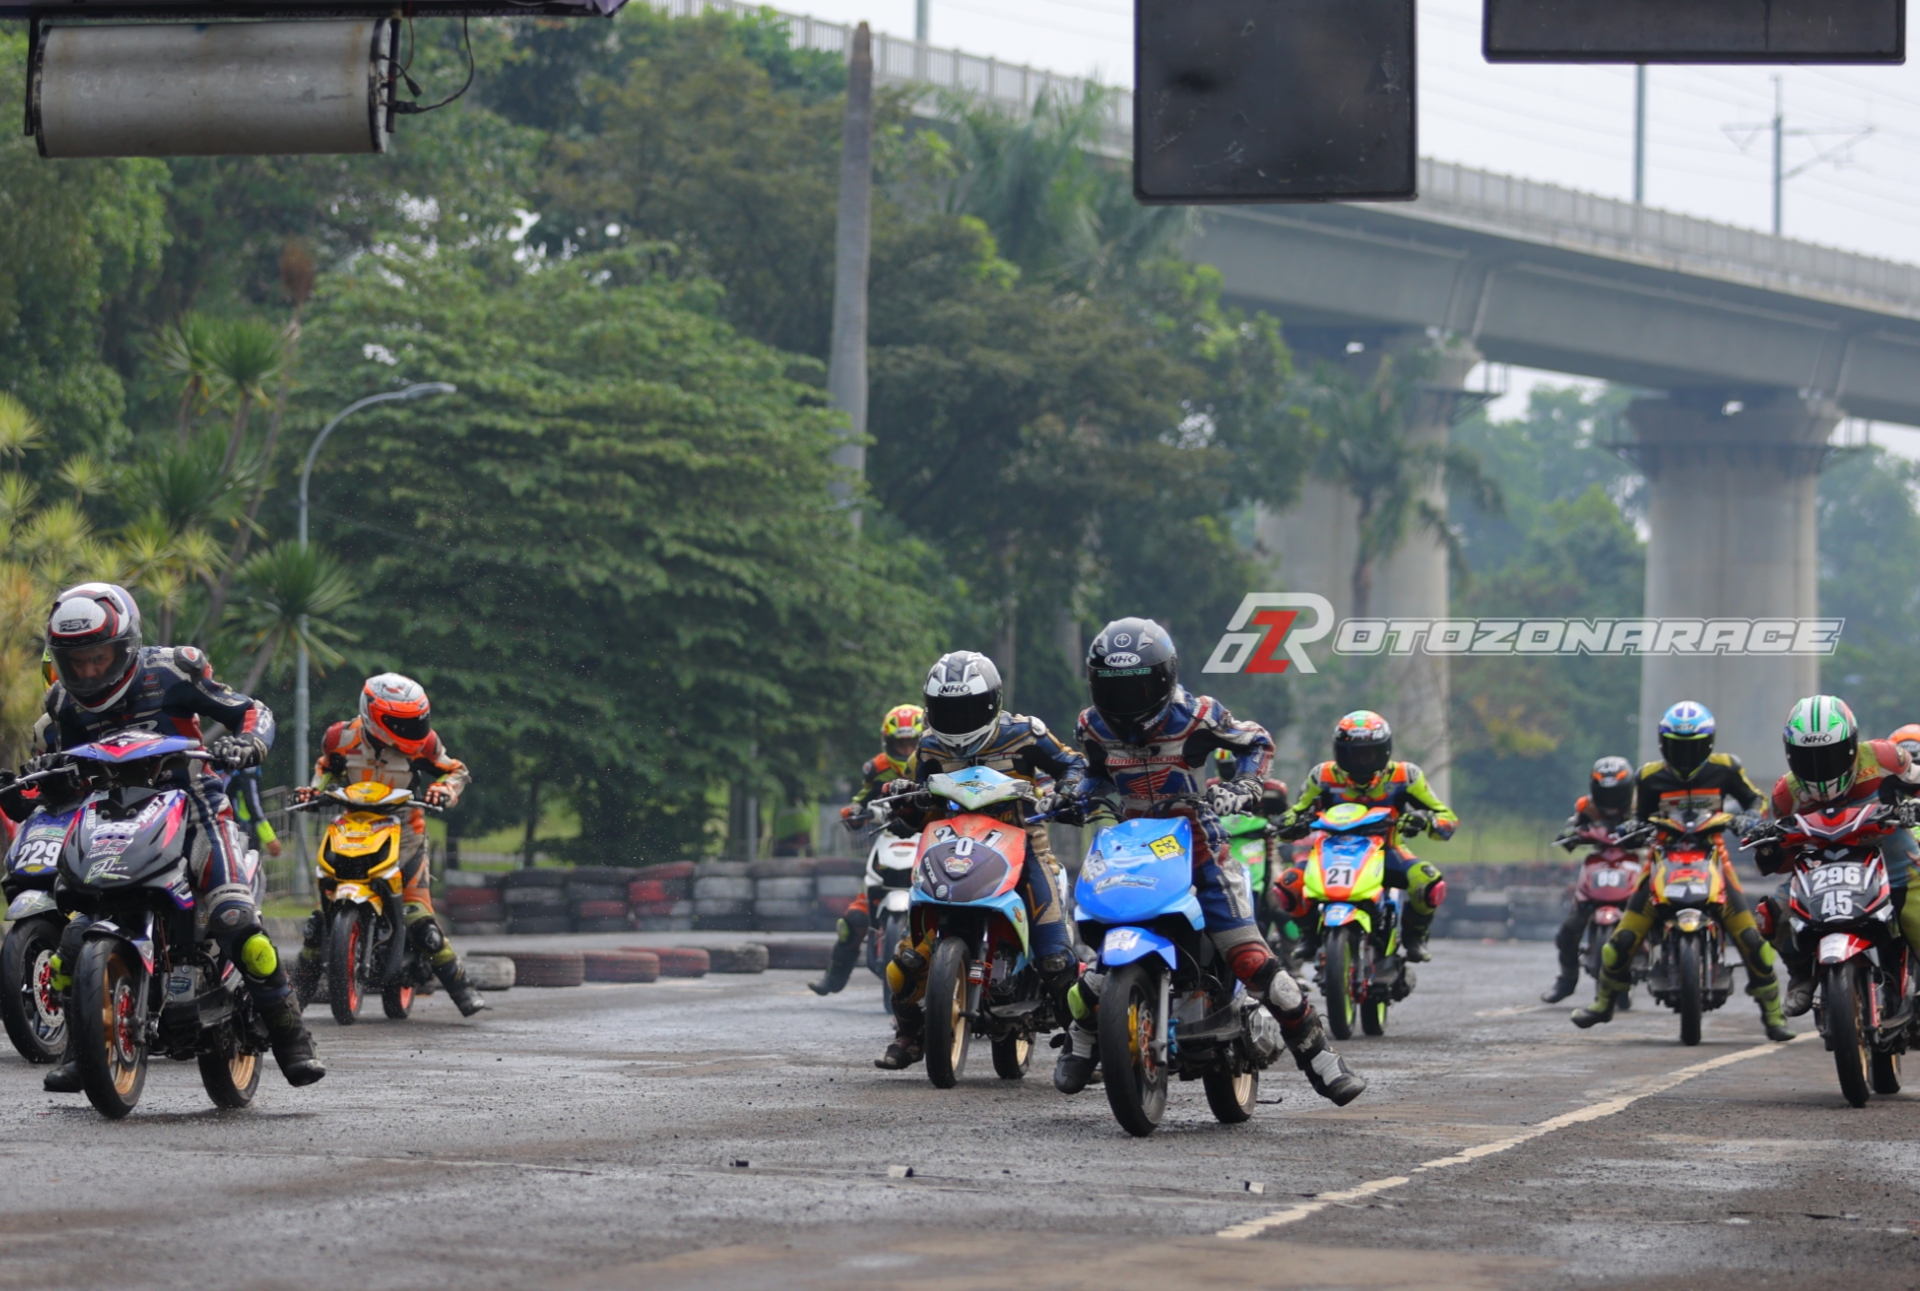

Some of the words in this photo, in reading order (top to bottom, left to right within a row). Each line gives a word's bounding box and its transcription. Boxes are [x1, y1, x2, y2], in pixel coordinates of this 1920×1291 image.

[58, 618, 92, 632] RSV
[1109, 655, 1137, 664] NHK
[941, 684, 968, 694] NHK
[1803, 734, 1829, 743] NHK
[15, 840, 62, 870] 229
[1326, 867, 1352, 886] 21
[1811, 866, 1861, 892] 296
[1821, 890, 1853, 916] 45
